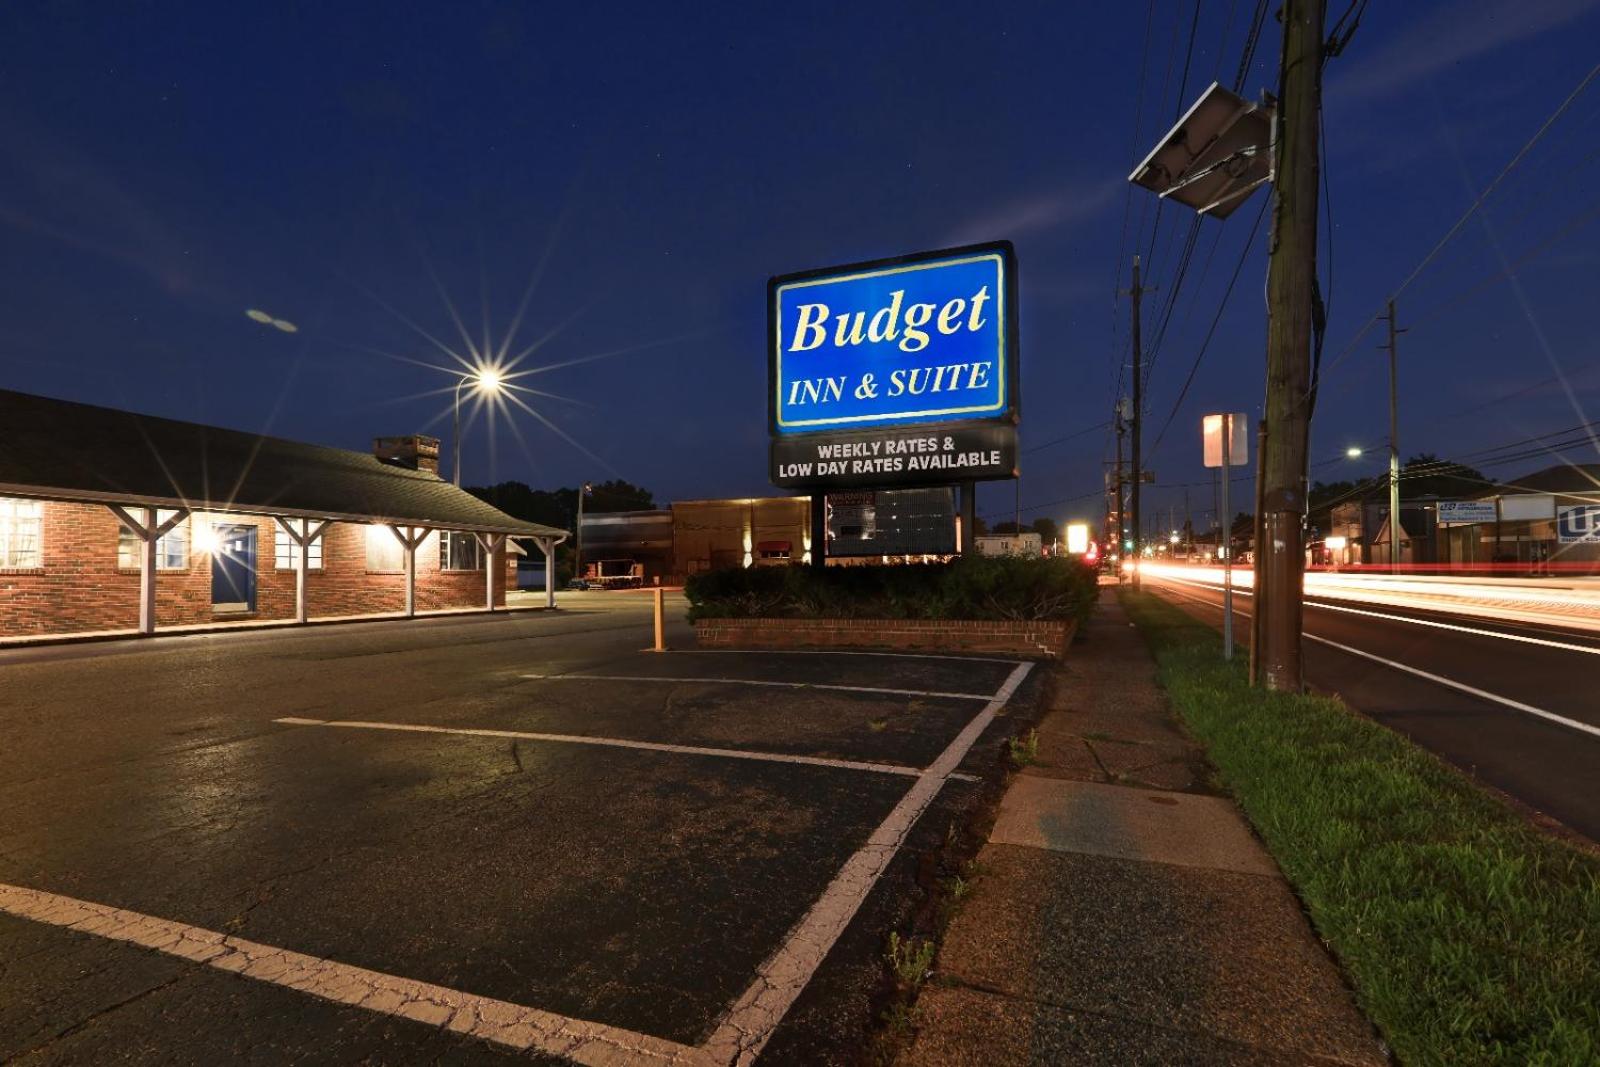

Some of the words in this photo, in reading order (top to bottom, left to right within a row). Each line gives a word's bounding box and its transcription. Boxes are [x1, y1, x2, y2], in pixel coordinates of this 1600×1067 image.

[788, 286, 990, 352] Budget
[787, 376, 847, 406] INN
[854, 373, 878, 400] &
[887, 361, 992, 397] SUITE
[779, 462, 812, 478] LOW
[817, 460, 847, 476] DAY
[852, 456, 903, 474] RATES
[907, 450, 1001, 470] AVAILABLE
[817, 442, 881, 459] WEEKLY
[885, 438, 937, 455] RATES
[942, 436, 955, 451] &
